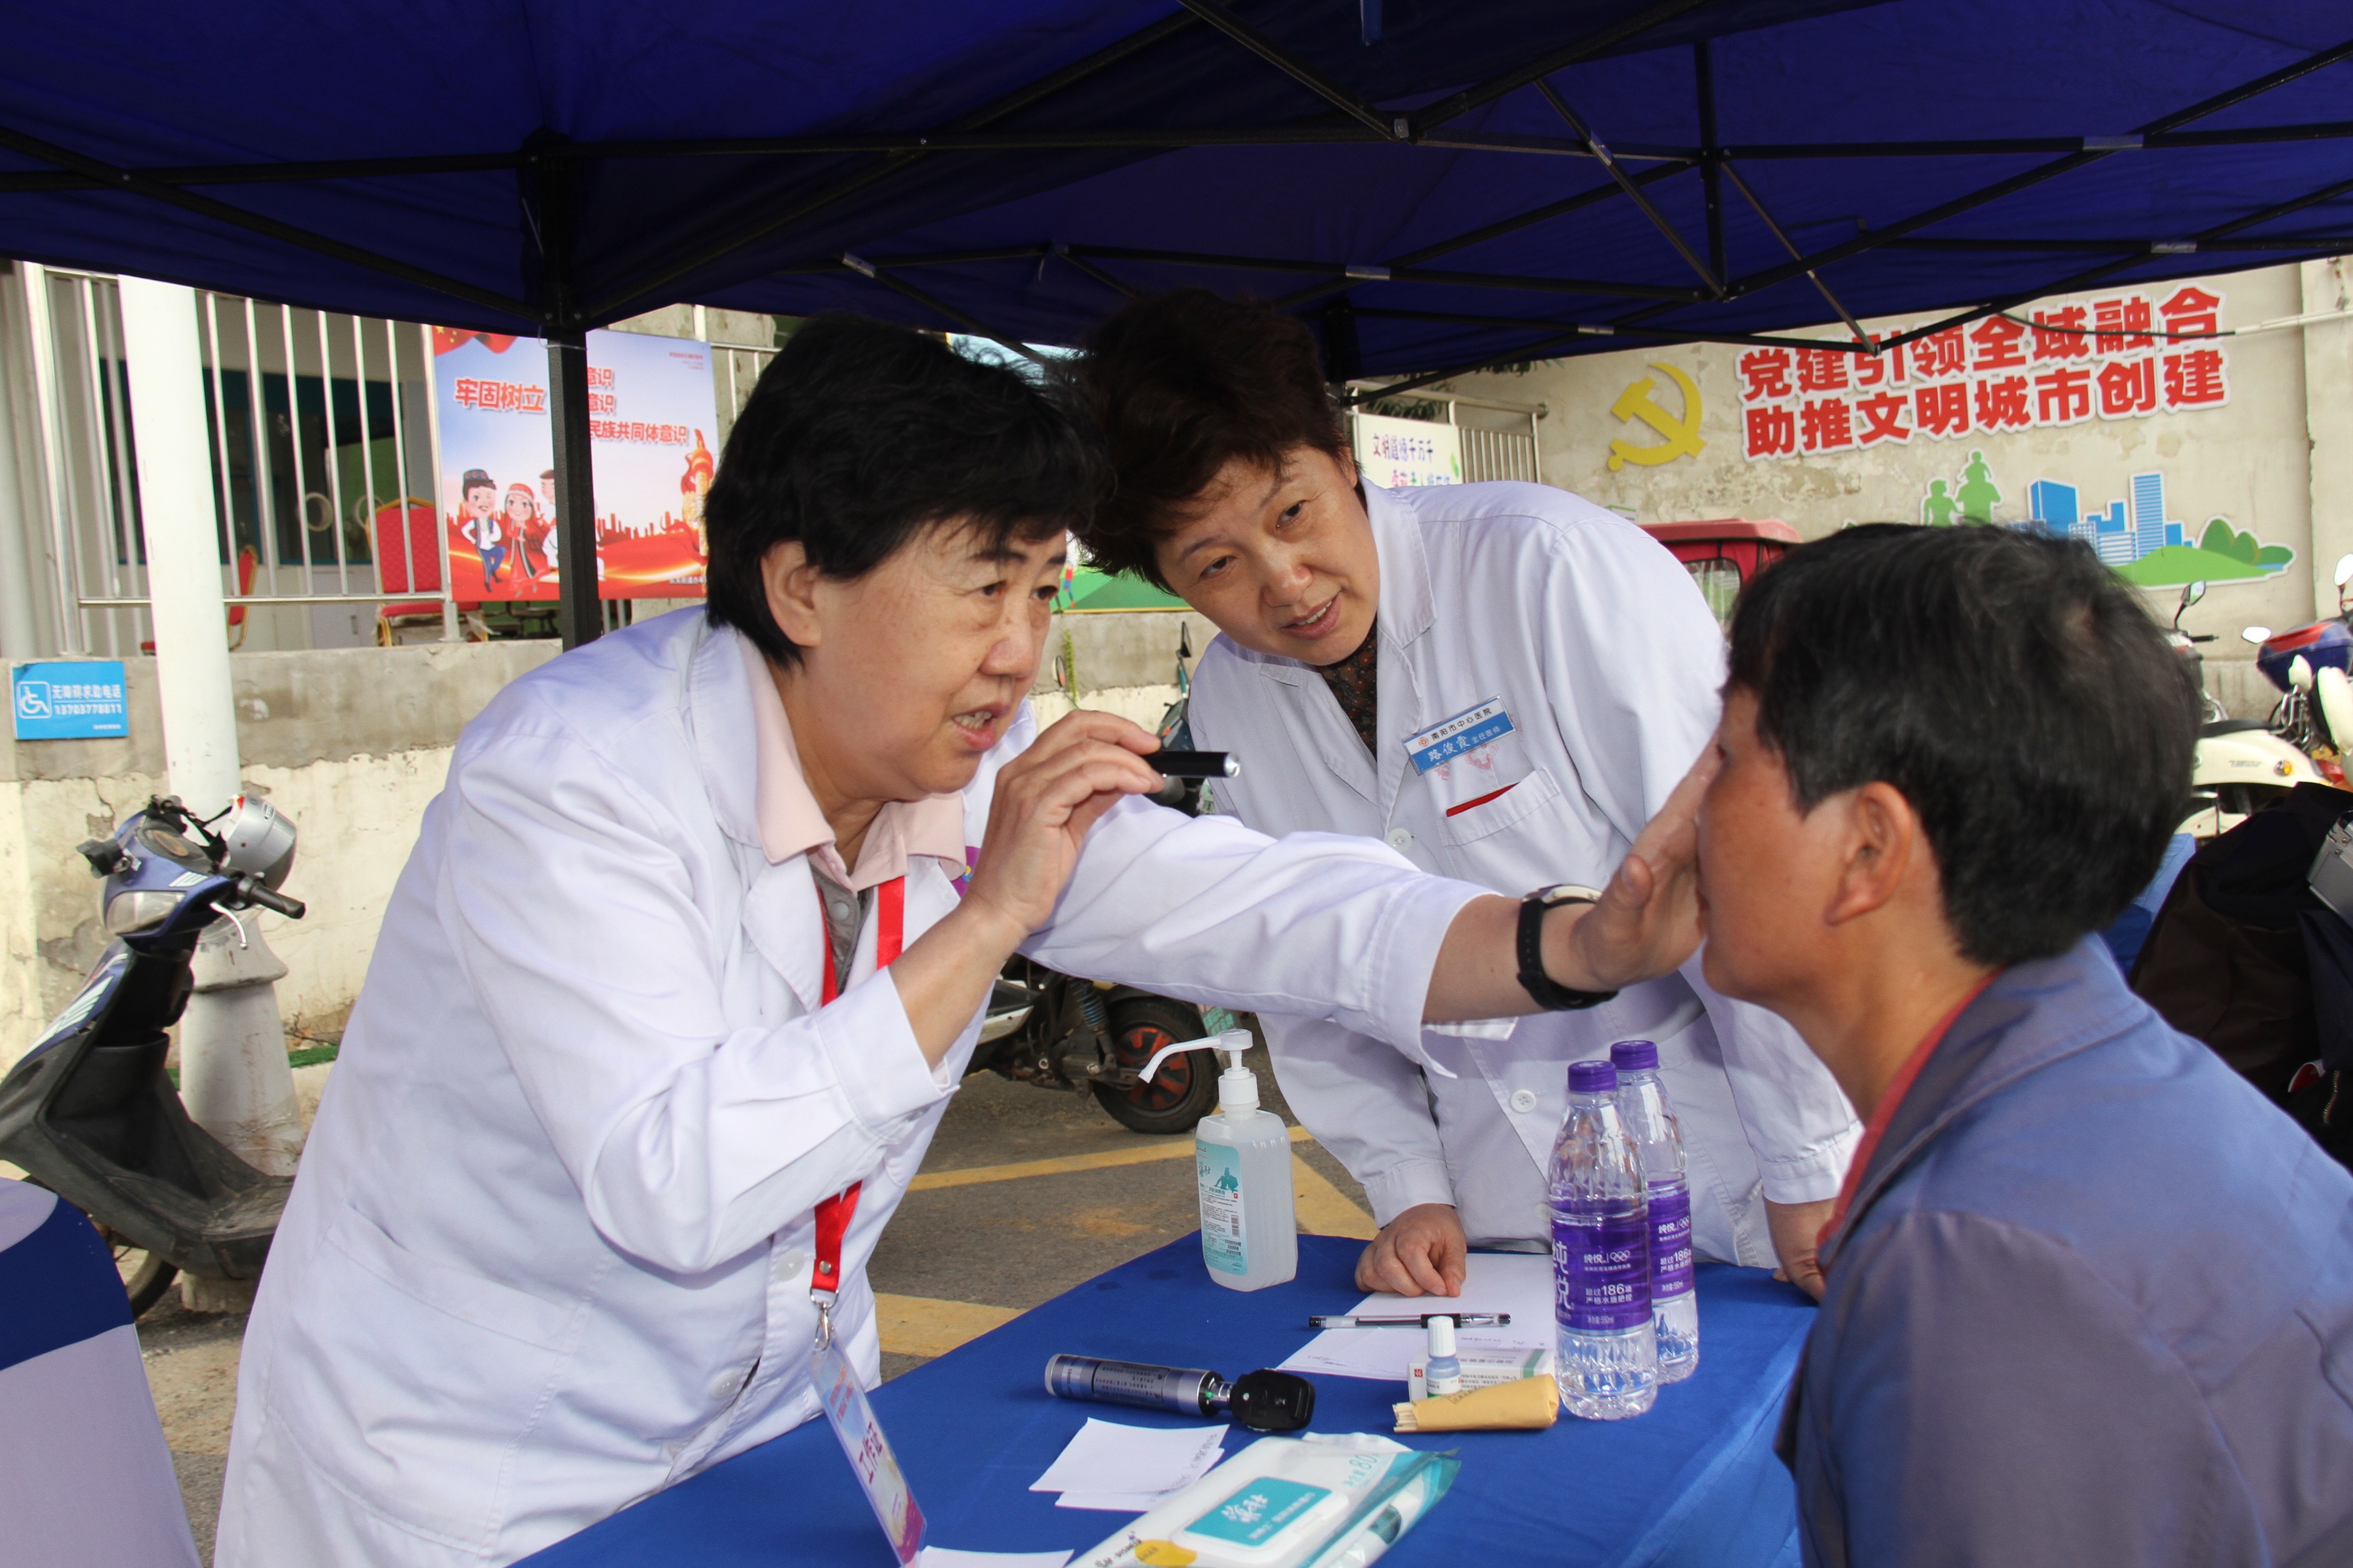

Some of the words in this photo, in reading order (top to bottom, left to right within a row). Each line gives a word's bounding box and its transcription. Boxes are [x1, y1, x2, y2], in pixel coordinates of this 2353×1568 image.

[1741, 287, 2222, 402] 党建引领全域融合
[587, 366, 613, 387] 意识
[455, 378, 545, 413] 牢固树立
[588, 393, 615, 413] 意识
[1746, 350, 2225, 457] 助推文明城市创建
[590, 419, 688, 444] 民族共同体意识
[1431, 707, 1493, 741] 南阳市中心医院
[1471, 725, 1501, 744] 主任医师
[1428, 735, 1471, 762] 路俊霞
[1586, 1283, 1632, 1296] 超过186项
[859, 1420, 883, 1484] 工作证
